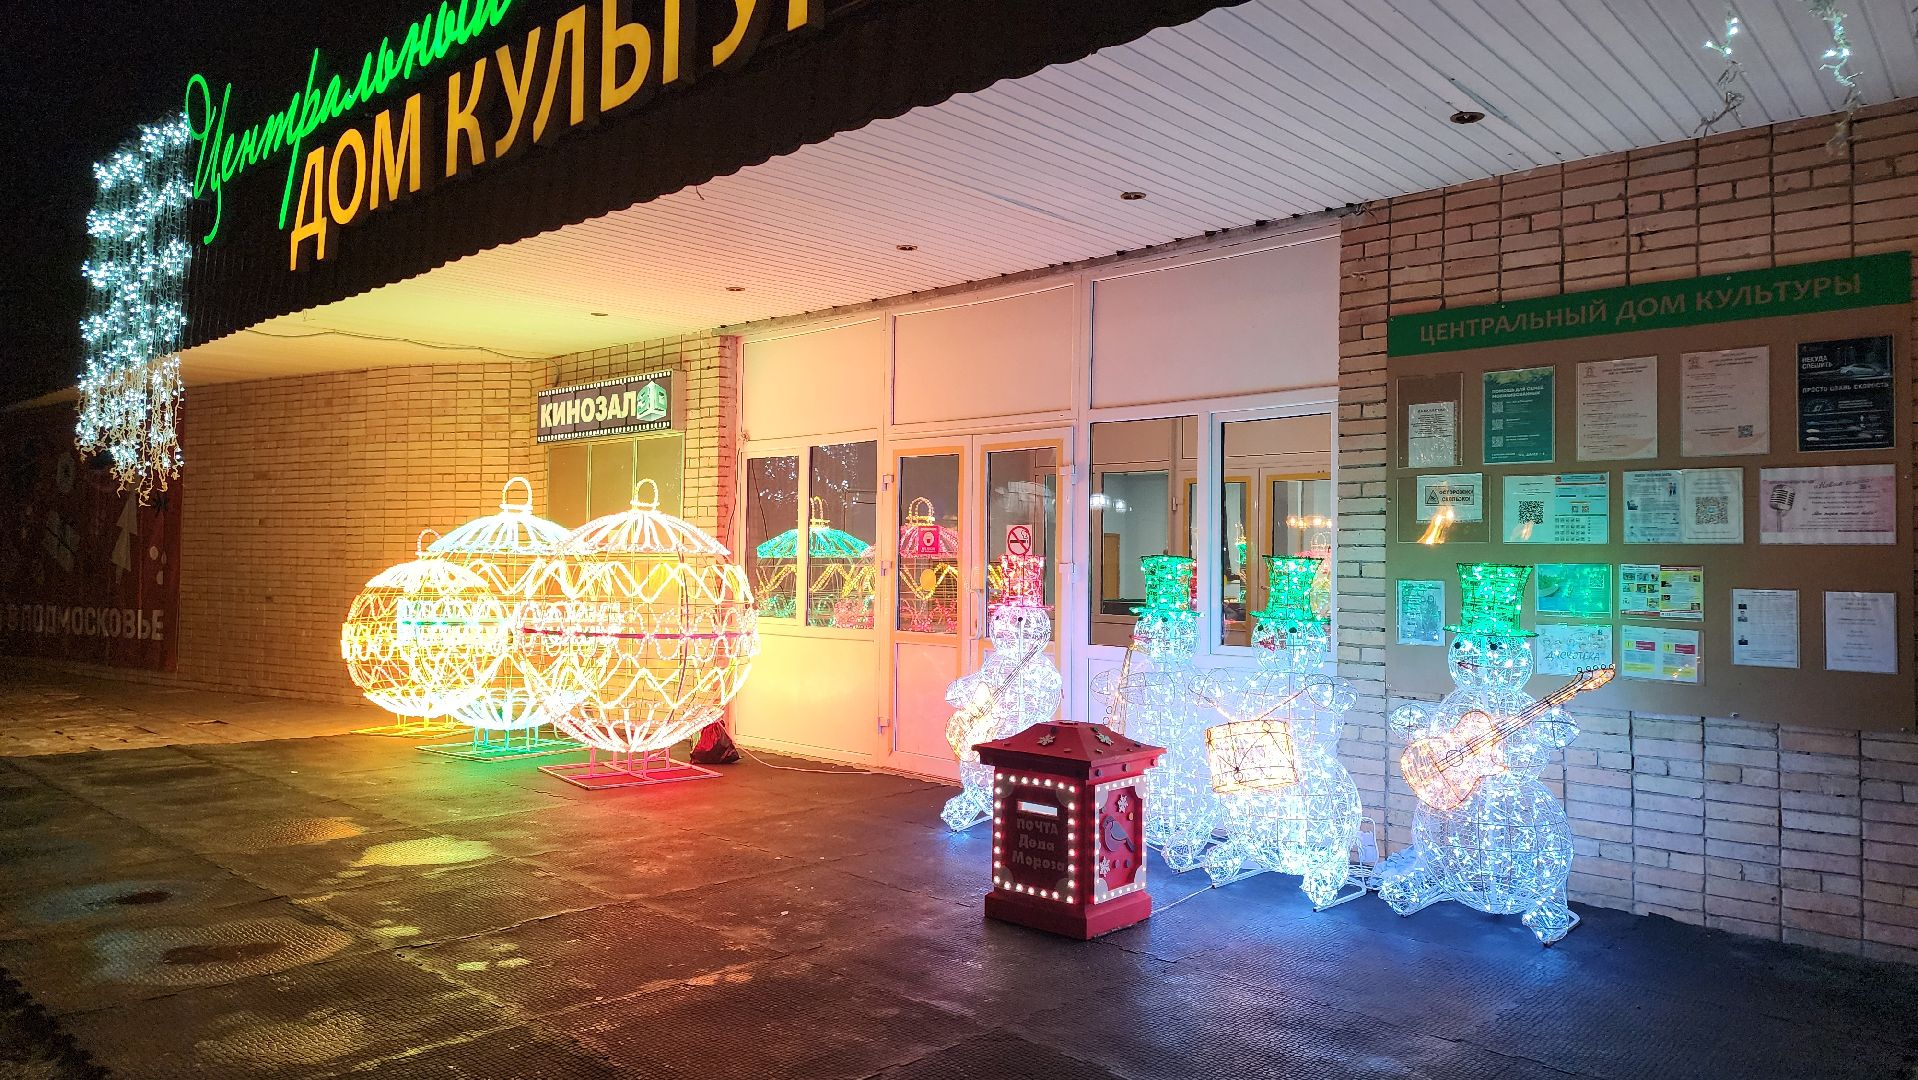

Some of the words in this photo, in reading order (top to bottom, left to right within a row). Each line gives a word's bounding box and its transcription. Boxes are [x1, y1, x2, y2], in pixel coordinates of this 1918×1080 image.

[290, 93, 421, 271] ДОМ
[446, 0, 808, 178] КУЛЬ
[1420, 299, 1607, 346] ЦЕНТРАЛЬНЫЙ
[1615, 294, 1686, 326] ДОМ
[1696, 273, 1861, 312] КУЛЬТУРЫ
[540, 390, 637, 429] КИНОЗАЛ
[1017, 818, 1058, 836] ПОЧТА
[1018, 833, 1055, 851] Деда
[1012, 849, 1066, 872] Мороза
